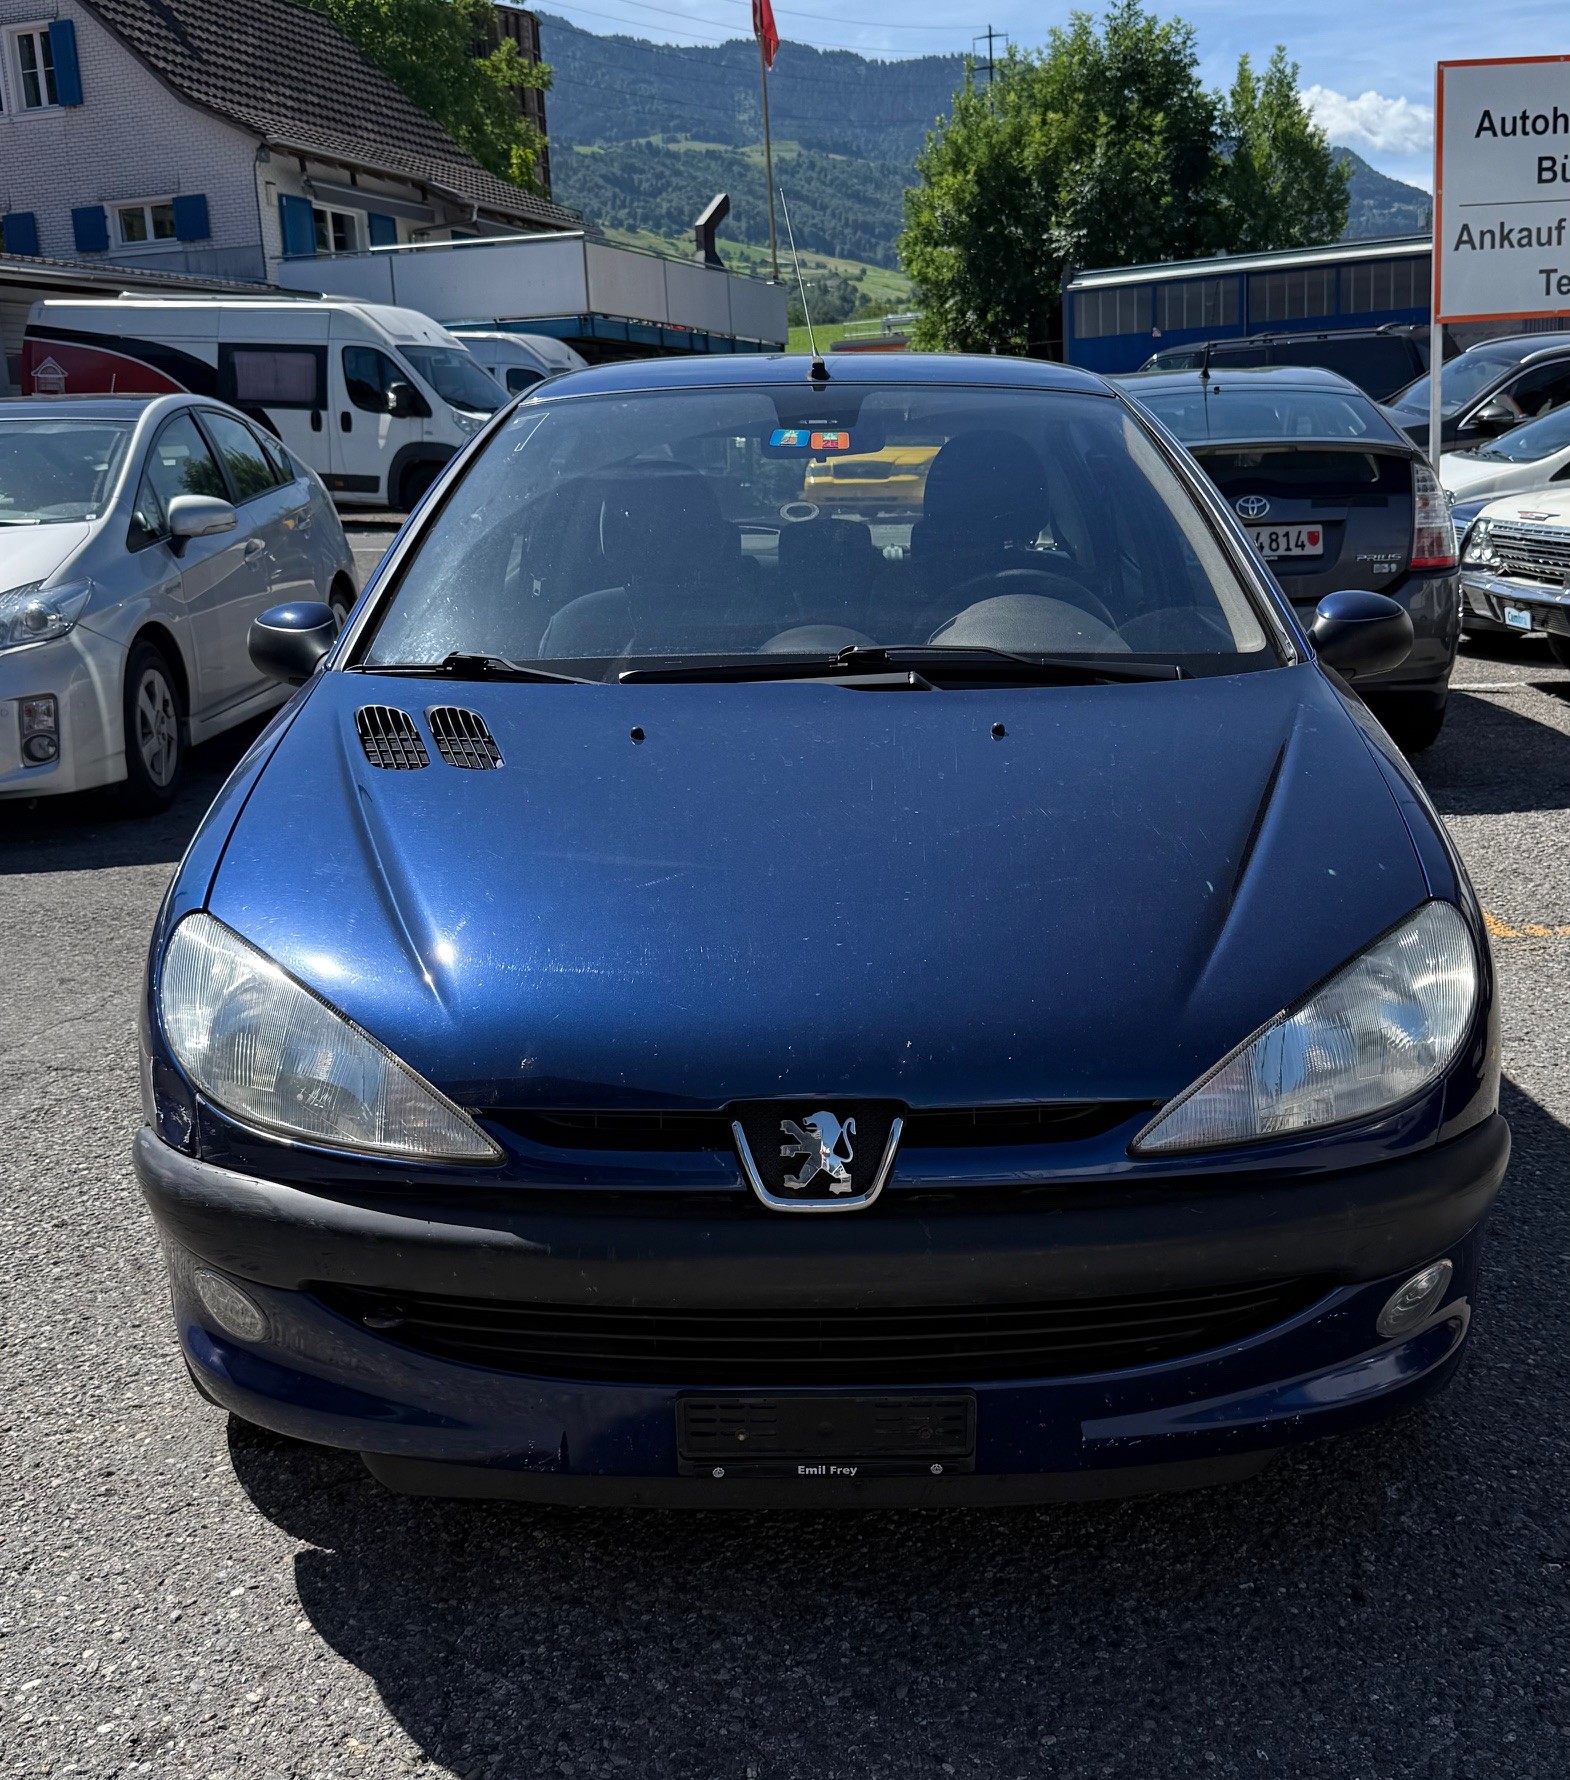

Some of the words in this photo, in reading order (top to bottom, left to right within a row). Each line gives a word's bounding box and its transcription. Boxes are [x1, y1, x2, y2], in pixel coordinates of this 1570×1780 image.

[1475, 106, 1569, 138] Autoh
[1453, 217, 1567, 251] Ankauf
[1538, 268, 1570, 296] Te
[1356, 553, 1402, 561] PRIUS
[797, 1465, 826, 1475] Emil
[829, 1465, 858, 1477] Frey
